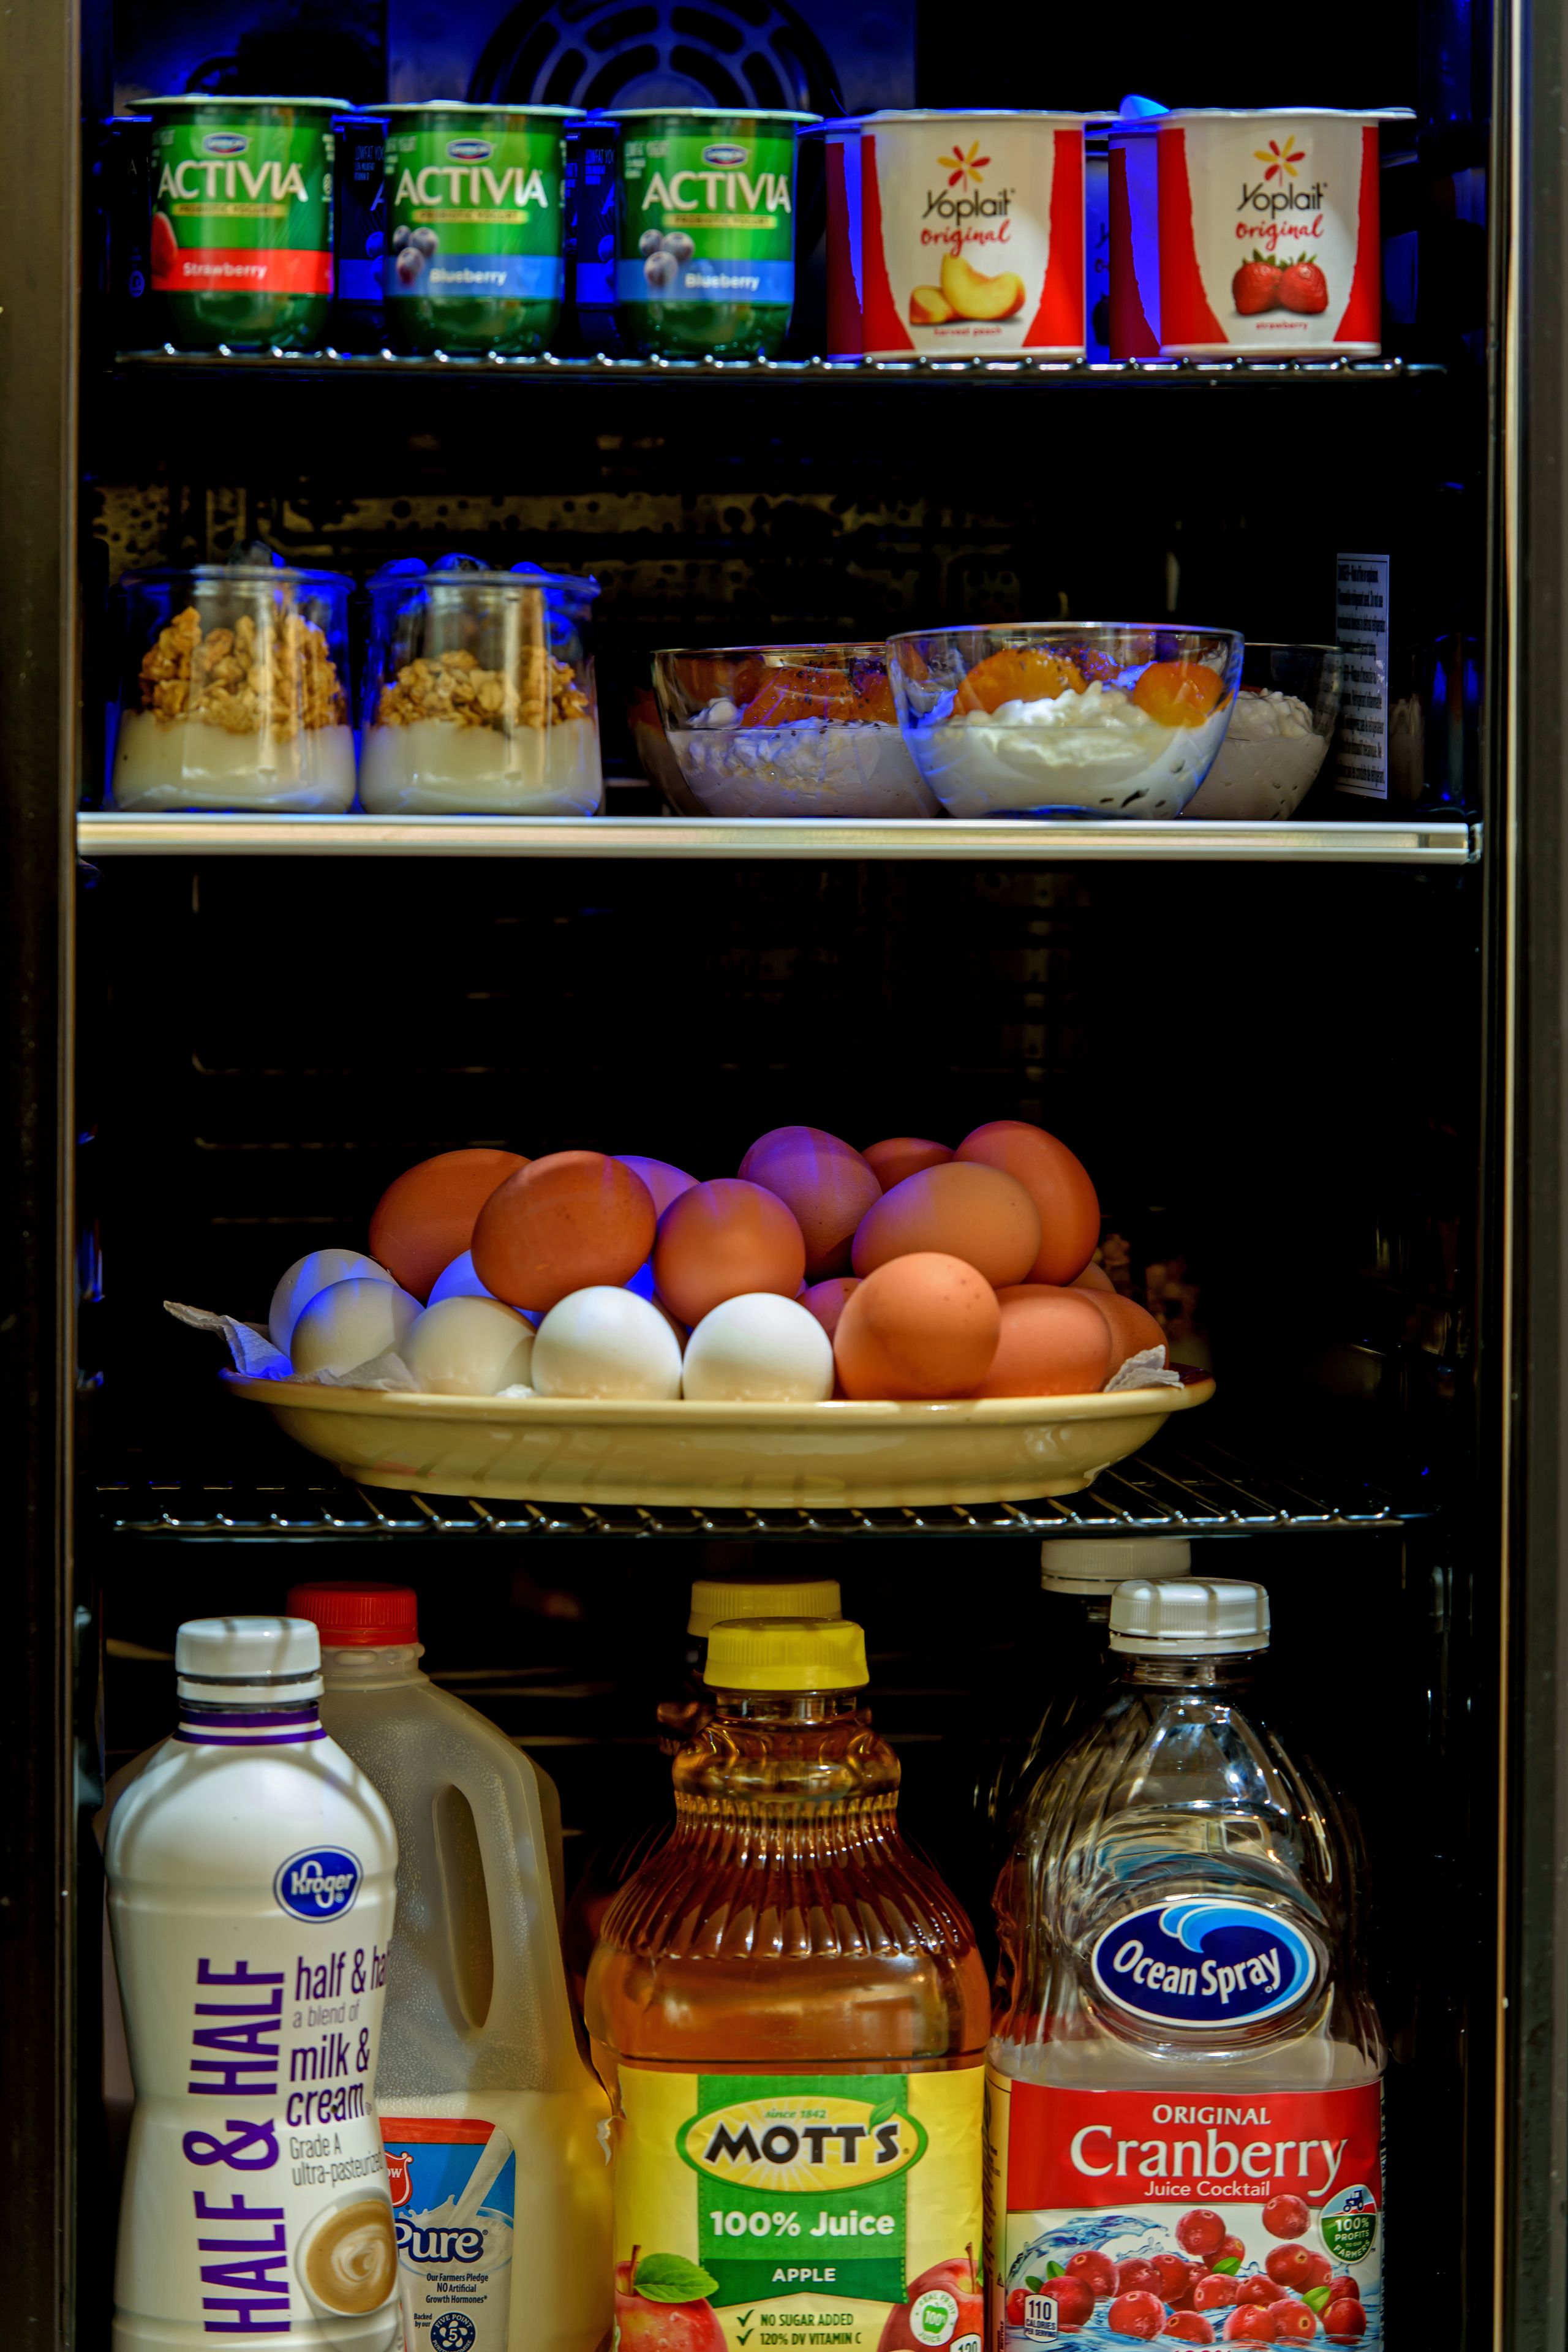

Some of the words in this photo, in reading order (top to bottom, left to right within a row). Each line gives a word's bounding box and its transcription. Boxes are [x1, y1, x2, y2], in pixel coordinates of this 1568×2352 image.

[157, 160, 308, 202] ACTIVIA
[394, 166, 548, 208] ACTIVIA
[642, 172, 791, 213] ACTIVIA
[922, 189, 1011, 225] Yoplait
[1237, 183, 1324, 219] Yoplait
[921, 219, 1011, 259] original
[1235, 214, 1324, 251] original
[183, 263, 267, 281] Strawberry
[430, 268, 507, 286] Blueberry
[685, 273, 760, 291] Blueberry
[291, 1860, 353, 1909] Kroger
[295, 1951, 347, 2001] half
[351, 1948, 366, 1994] &
[1113, 1939, 1197, 1996] Ocean
[1201, 1947, 1281, 2004] Spray
[187, 1958, 285, 2095] HALF
[292, 2011, 303, 2029] a
[307, 2002, 346, 2027] blend
[349, 1999, 360, 2021] of
[290, 2032, 350, 2082] milk
[356, 2027, 370, 2073] &
[286, 2082, 364, 2127] cream
[764, 2108, 797, 2119] since
[800, 2109, 827, 2119] 1842
[1152, 2105, 1271, 2125] ORIGINAL
[183, 2119, 280, 2171] &
[290, 2134, 331, 2159] Grade
[334, 2132, 342, 2155] A
[1070, 2124, 1348, 2198] Cranberry
[1144, 2180, 1191, 2196] Juice
[1196, 2180, 1270, 2196] Cocktail
[709, 2211, 801, 2236] 100%
[810, 2210, 895, 2236] Juice
[1335, 2217, 1370, 2232] 100%
[1335, 2230, 1370, 2241] PROFITS
[395, 2222, 480, 2260] Pure
[1333, 2240, 1370, 2258] FARMERS
[193, 2190, 291, 2333] HALF
[772, 2268, 836, 2282] APPLE
[427, 2273, 438, 2282] Our
[466, 2273, 488, 2283] Pledge
[437, 2283, 448, 2293] NO
[449, 2284, 476, 2293] Artificial
[435, 2315, 451, 2328] FIVE
[452, 2314, 473, 2328] POINT
[761, 2314, 775, 2326] NO
[779, 2314, 814, 2326] SUGAR
[818, 2313, 853, 2326] ADDED
[1029, 2300, 1051, 2320] 110
[448, 2329, 458, 2341] 5
[760, 2333, 788, 2345] 120%
[792, 2334, 806, 2345] DV
[809, 2332, 852, 2345] VITAMIN
[856, 2332, 861, 2344] C
